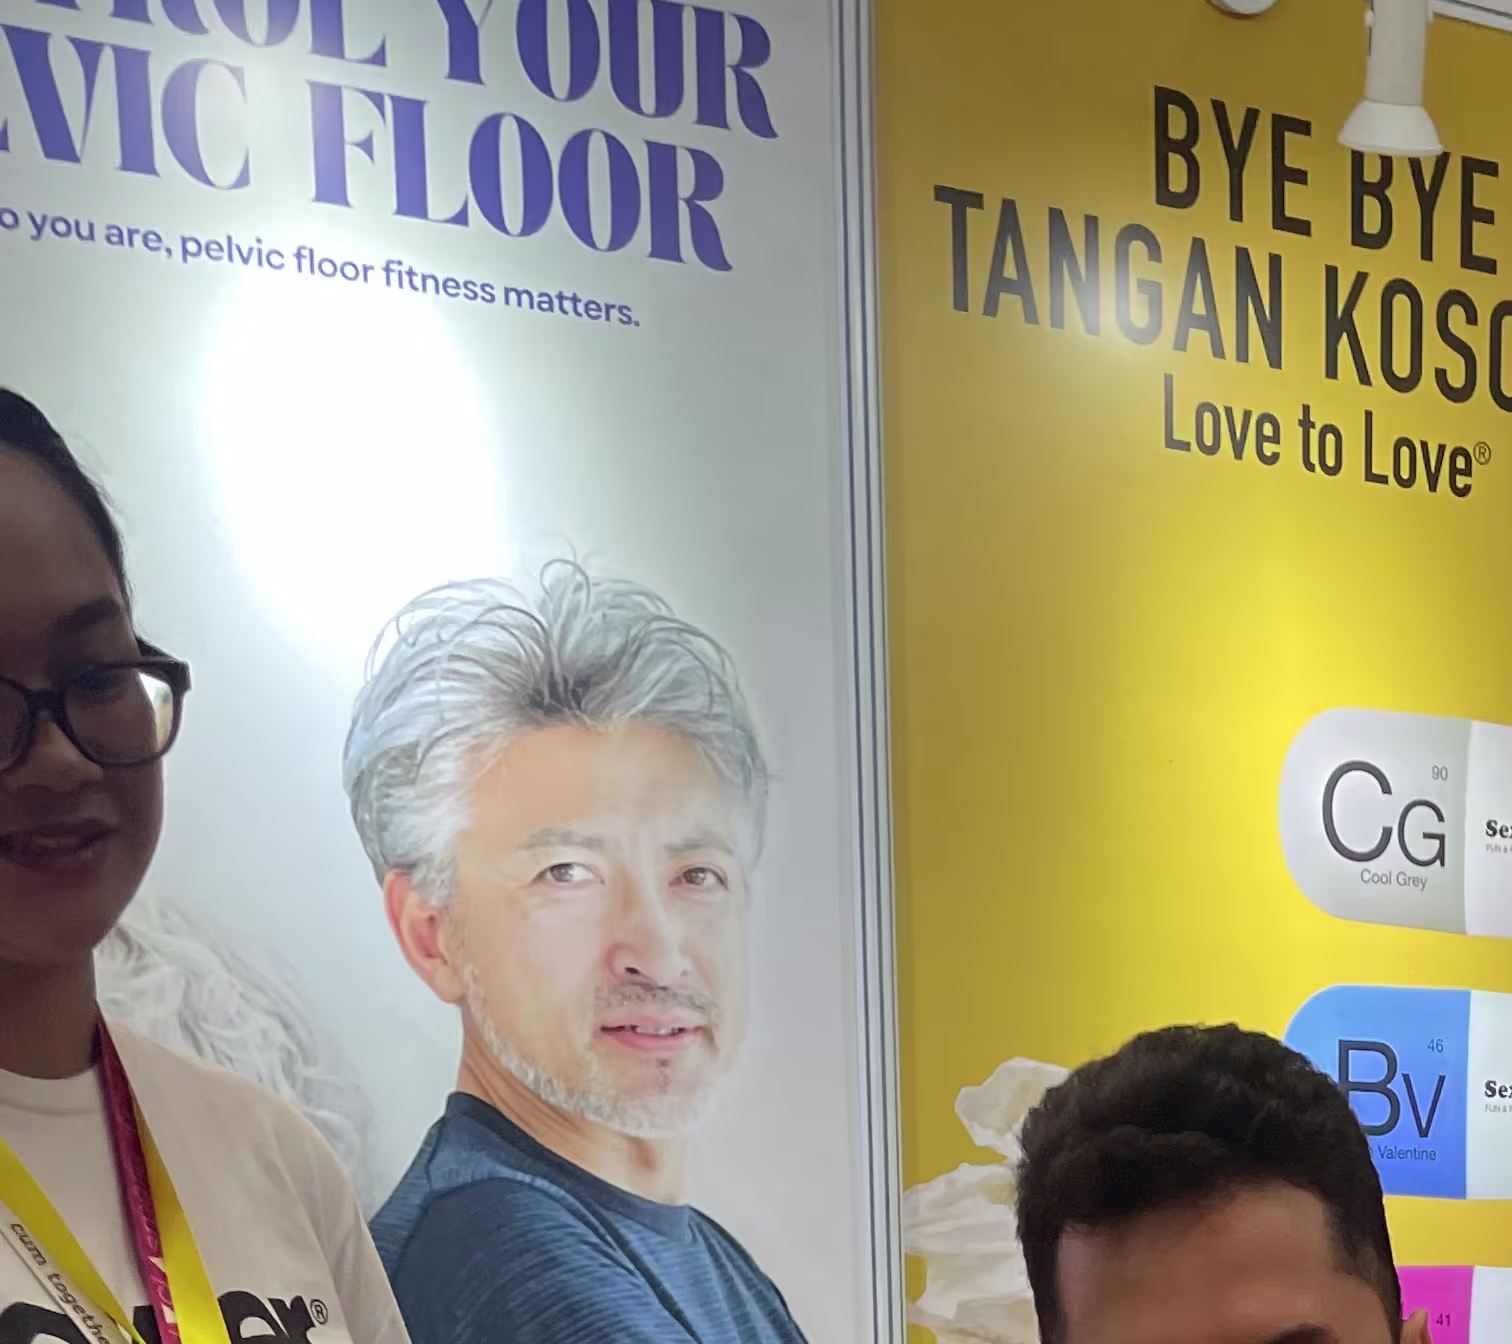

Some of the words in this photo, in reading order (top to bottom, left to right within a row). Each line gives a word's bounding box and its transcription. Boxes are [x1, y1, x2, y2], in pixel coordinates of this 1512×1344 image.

[430, 0, 778, 139] YOUR
[0, 24, 251, 190] VIC
[305, 79, 733, 272] FLOOR
[1154, 84, 1312, 238] BYE
[1350, 152, 1499, 276] BYE
[27, 211, 96, 242] you
[104, 223, 173, 259] are,
[181, 235, 285, 271] pelvic
[293, 244, 375, 284] floor
[382, 259, 496, 304] fitness
[504, 285, 640, 327] matters.
[933, 184, 1282, 371] TANGAN
[1163, 373, 1281, 467] Love
[1299, 404, 1343, 477] to
[1432, 765, 1448, 781] 90
[1360, 868, 1392, 887] Cool
[1396, 871, 1428, 891] Grey
[1427, 1039, 1444, 1053] 46
[1378, 1145, 1437, 1161] Valentine
[11, 1223, 47, 1266] cum
[1436, 1313, 1450, 1327] 41
